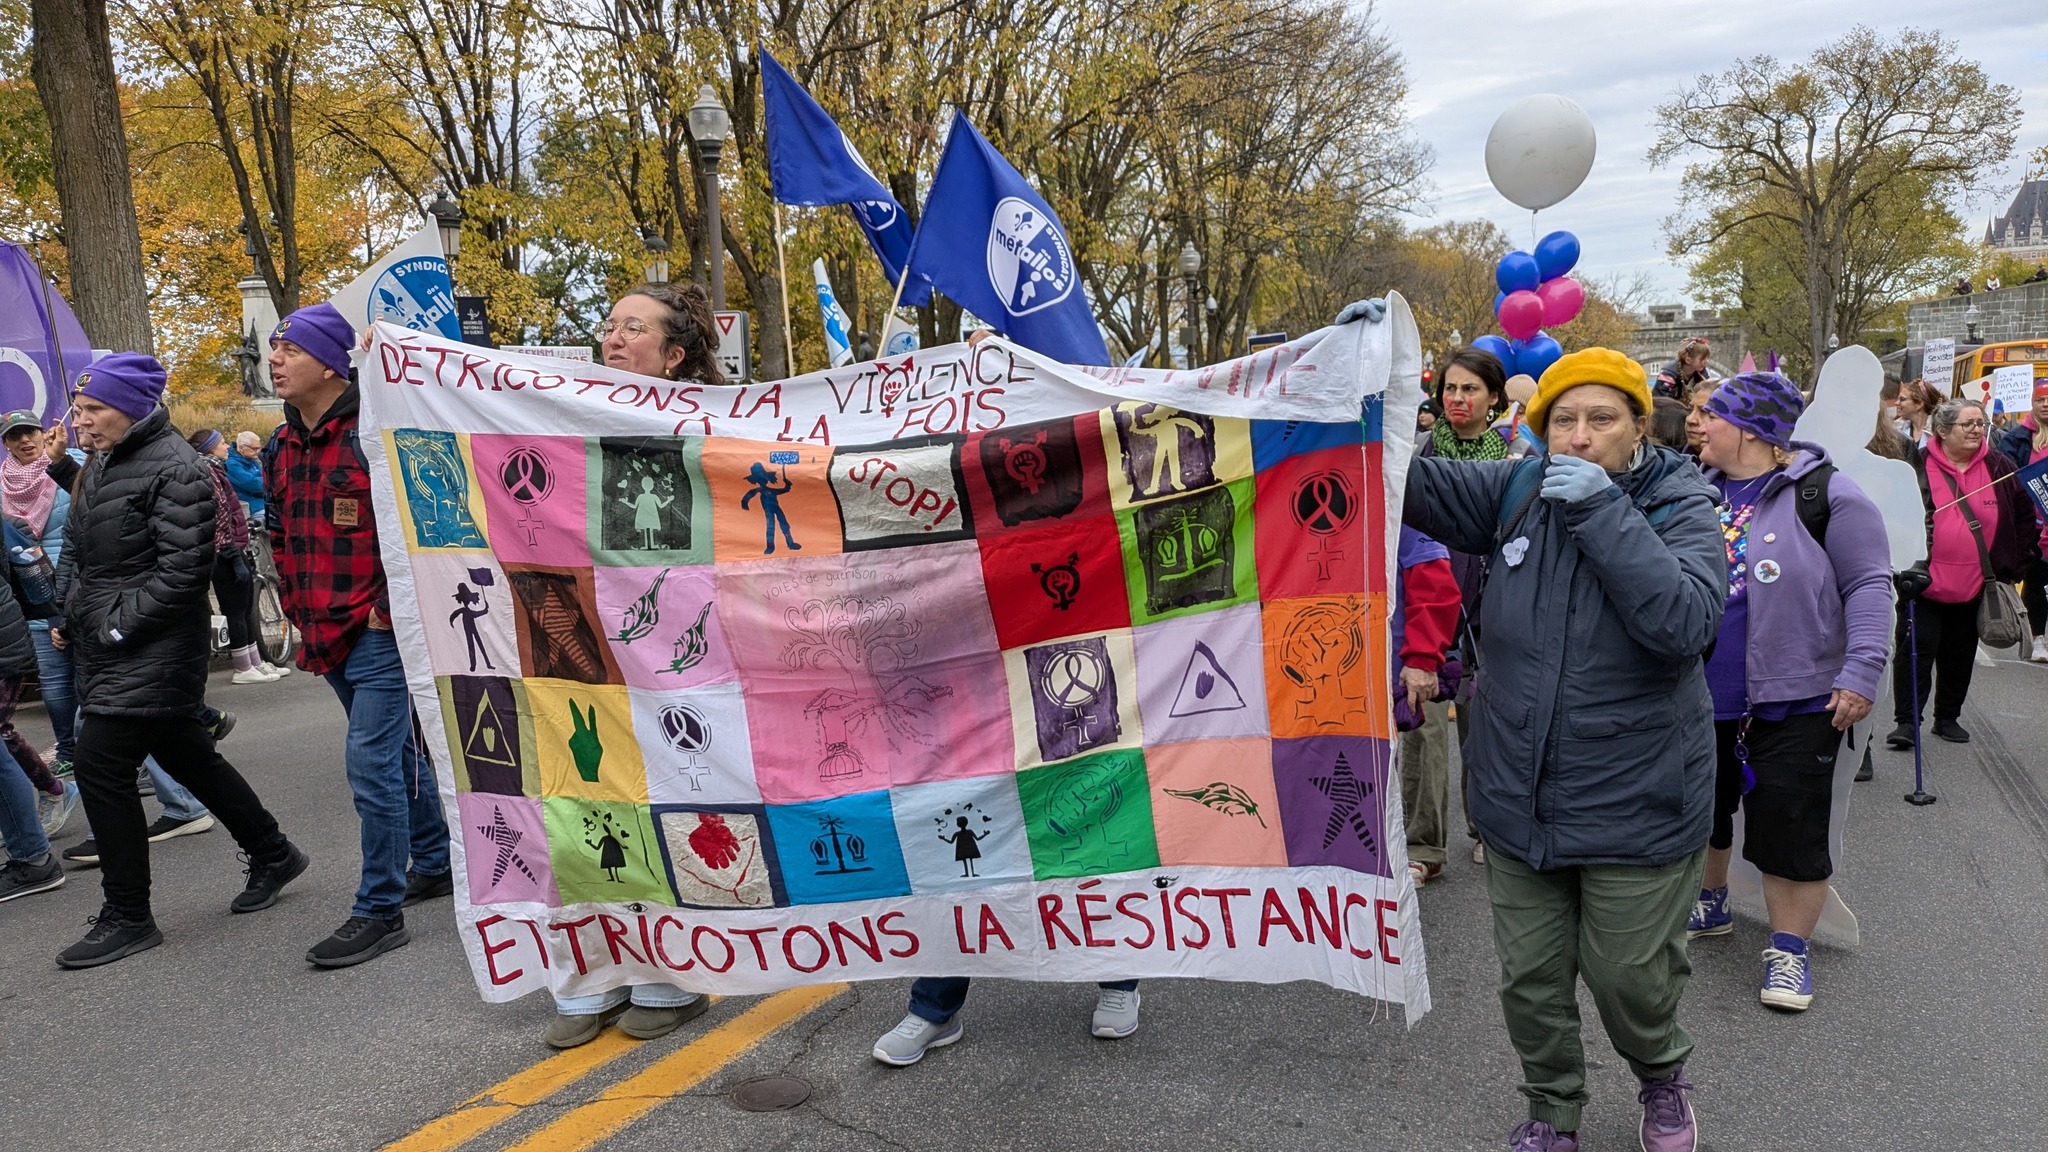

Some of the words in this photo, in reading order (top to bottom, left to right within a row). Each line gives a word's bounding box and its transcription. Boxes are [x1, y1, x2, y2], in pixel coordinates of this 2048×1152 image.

[395, 261, 448, 277] SYNDIC
[426, 285, 439, 295] des
[996, 228, 1064, 292] métallos
[380, 335, 704, 414] DÉTRICOTONS
[729, 384, 782, 419] LA
[824, 344, 1036, 414] VIOLENCE
[2025, 347, 2048, 360] SPE
[776, 415, 830, 447] LA
[893, 387, 1006, 440] FOIS
[849, 458, 957, 531] STOP!
[763, 578, 799, 600] VOIES
[806, 571, 820, 584] de
[547, 911, 920, 976] TRICOTONS
[953, 903, 1015, 954] LA
[1037, 879, 1401, 965] RÉSISTANCE
